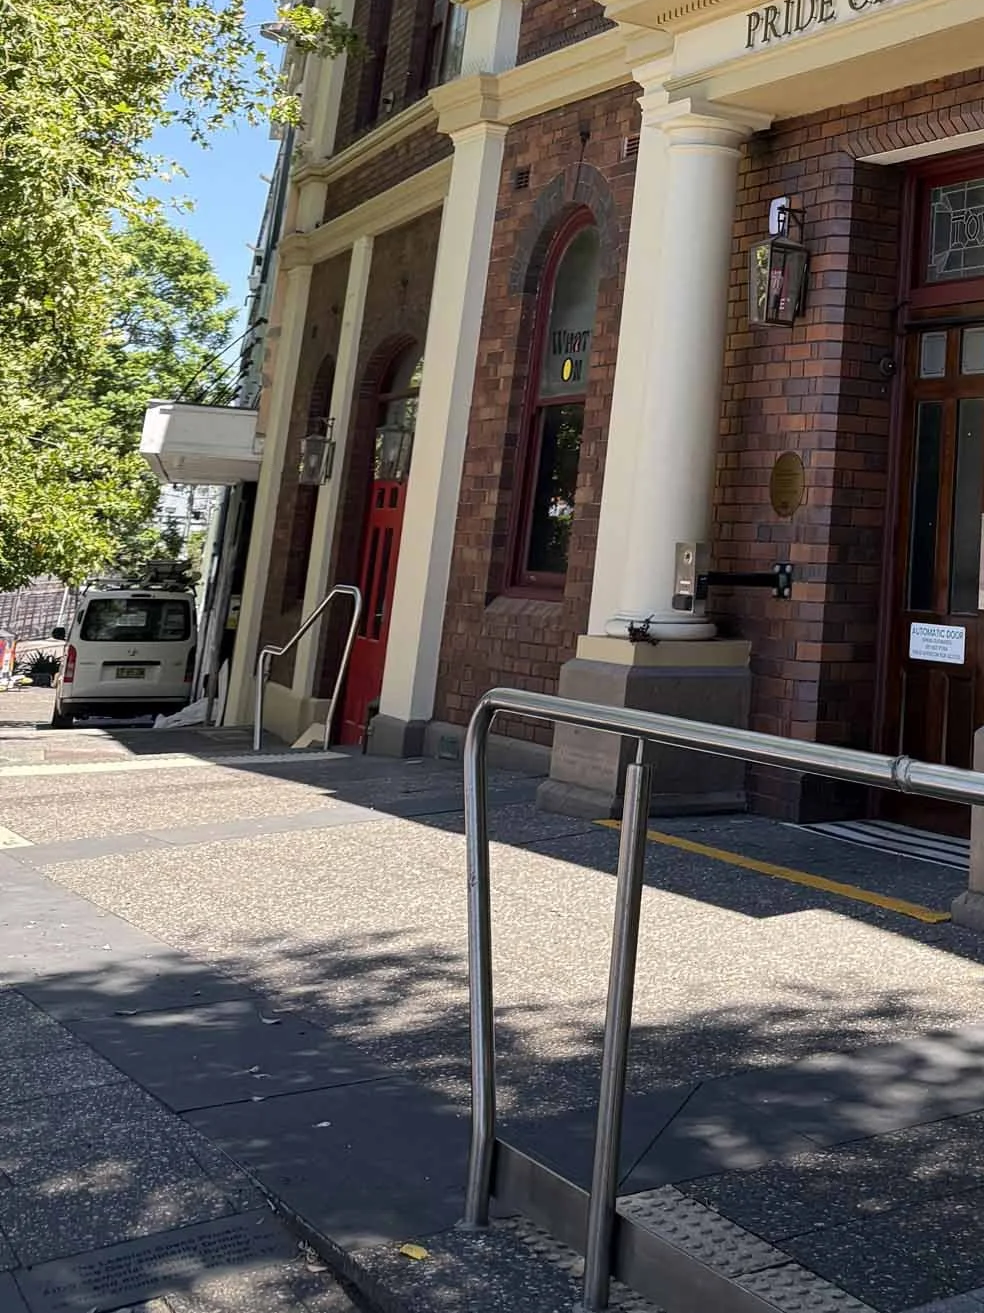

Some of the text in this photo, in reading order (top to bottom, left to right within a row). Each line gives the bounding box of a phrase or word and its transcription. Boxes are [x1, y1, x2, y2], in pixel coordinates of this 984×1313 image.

[561, 357, 583, 383] ON
[912, 626, 964, 640] AUTOMATIC DOOR
